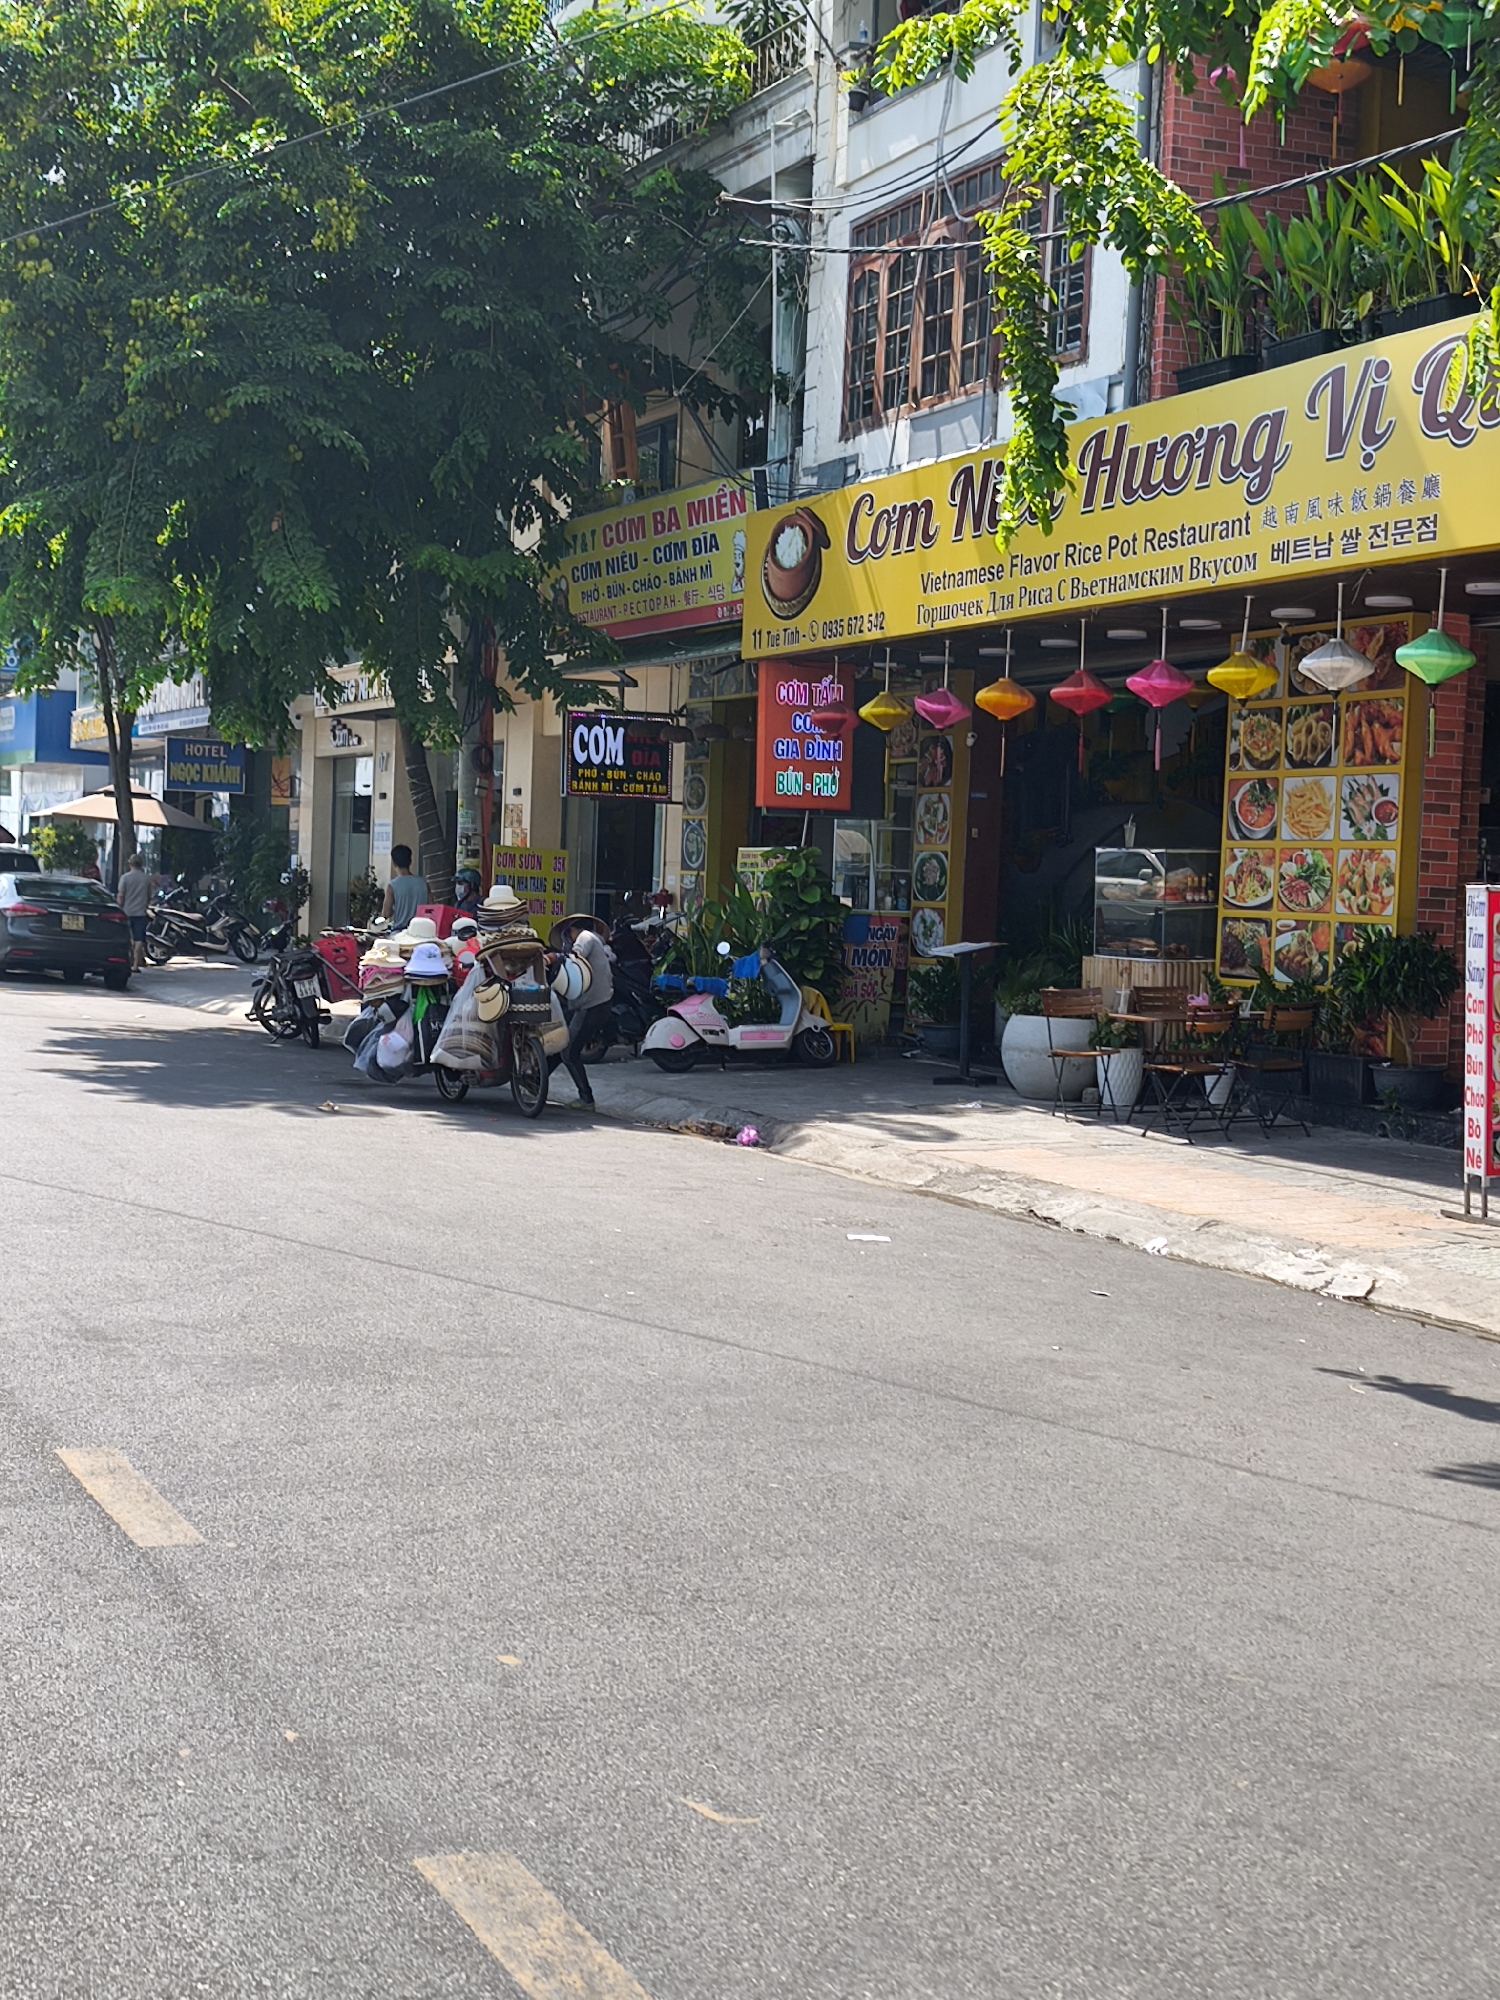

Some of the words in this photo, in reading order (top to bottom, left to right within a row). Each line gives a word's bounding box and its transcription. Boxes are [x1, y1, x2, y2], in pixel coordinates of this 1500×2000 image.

[846, 491, 940, 564] Cơm
[1078, 407, 1293, 515] Hương
[1306, 355, 1396, 469] Vị
[602, 515, 646, 548] CƠM
[652, 507, 681, 536] BA
[686, 484, 748, 528] MIỀN
[921, 562, 1004, 595] Vietnamese
[1009, 551, 1060, 579] Flavor
[1064, 539, 1102, 569] Rice
[1107, 530, 1138, 560] Pot
[1144, 510, 1251, 553] Restaurant
[1270, 531, 1334, 566] 베트남
[1339, 524, 1363, 555] 쌀
[1367, 514, 1440, 549] 전문점
[571, 560, 602, 584] CƠM
[605, 551, 638, 576] NIÊU
[653, 541, 687, 565] CƠM
[692, 532, 720, 556] ĐĨA
[632, 573, 662, 594] CHÁO
[669, 566, 698, 587] BÁNH
[700, 559, 713, 580] MÌ
[917, 598, 983, 626] Горшочек
[987, 591, 1014, 615] Для
[1019, 582, 1053, 608] Риса
[1070, 561, 1184, 600] Вьетнамским
[1189, 550, 1258, 581] Вкусом
[752, 629, 762, 650] 11
[822, 622, 844, 640] 0935
[847, 616, 864, 636] 672
[867, 611, 885, 631] 542
[776, 678, 808, 706] CƠM
[185, 743, 228, 758] HOTEL
[573, 719, 625, 766] CƠM
[774, 739, 801, 759] GIA
[804, 736, 843, 761] ĐÌNH
[170, 762, 200, 785] NGỌC
[202, 760, 241, 784] KHÁNH
[776, 766, 803, 796] BÚN
[497, 852, 516, 868] CƠM
[552, 878, 565, 893] 45K
[868, 923, 898, 941] NGÀY
[851, 945, 892, 967] MÓN
[1466, 1054, 1483, 1076] Bún
[1465, 1086, 1485, 1108] Cháo
[1467, 1116, 1481, 1139] Bò
[1466, 1146, 1482, 1169] Né
